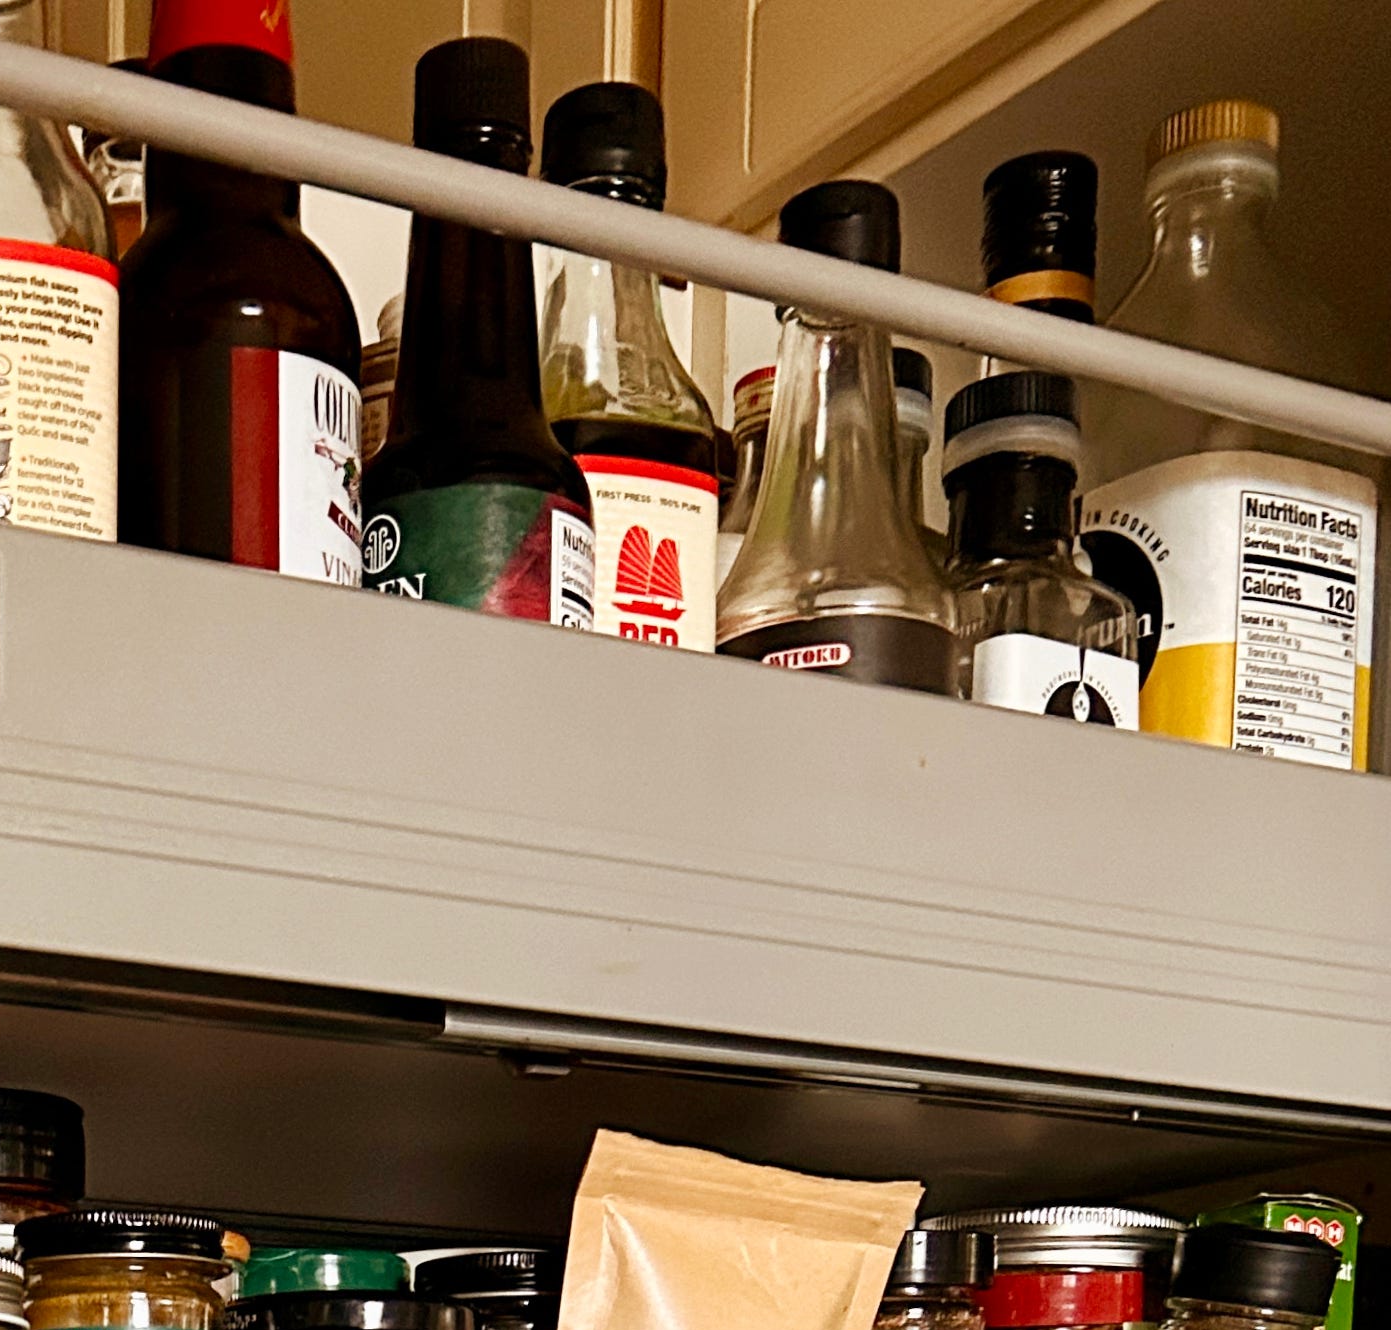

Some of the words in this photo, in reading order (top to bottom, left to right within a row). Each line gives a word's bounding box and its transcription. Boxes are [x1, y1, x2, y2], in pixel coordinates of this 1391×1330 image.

[30, 276, 48, 288] fish
[51, 281, 78, 294] sauce
[21, 290, 54, 305] brings
[57, 296, 80, 309] 100%
[83, 304, 103, 316] pure
[6, 305, 28, 315] your
[74, 315, 91, 327] Use
[93, 319, 99, 330] it
[0, 333, 19, 343] and
[57, 327, 93, 344] dipping
[56, 358, 74, 369] with
[63, 402, 76, 413] the
[597, 490, 621, 500] FIRST
[624, 492, 651, 503] PRESS
[682, 503, 701, 514] PURE
[1246, 498, 1316, 529] Nutrition
[1321, 512, 1357, 539] Facts
[1085, 510, 1101, 526] IN
[1110, 510, 1170, 563] COOKING
[1245, 537, 1280, 553] Serving
[1283, 544, 1299, 555] size
[1243, 576, 1301, 601] Calories
[1327, 586, 1354, 613] 120
